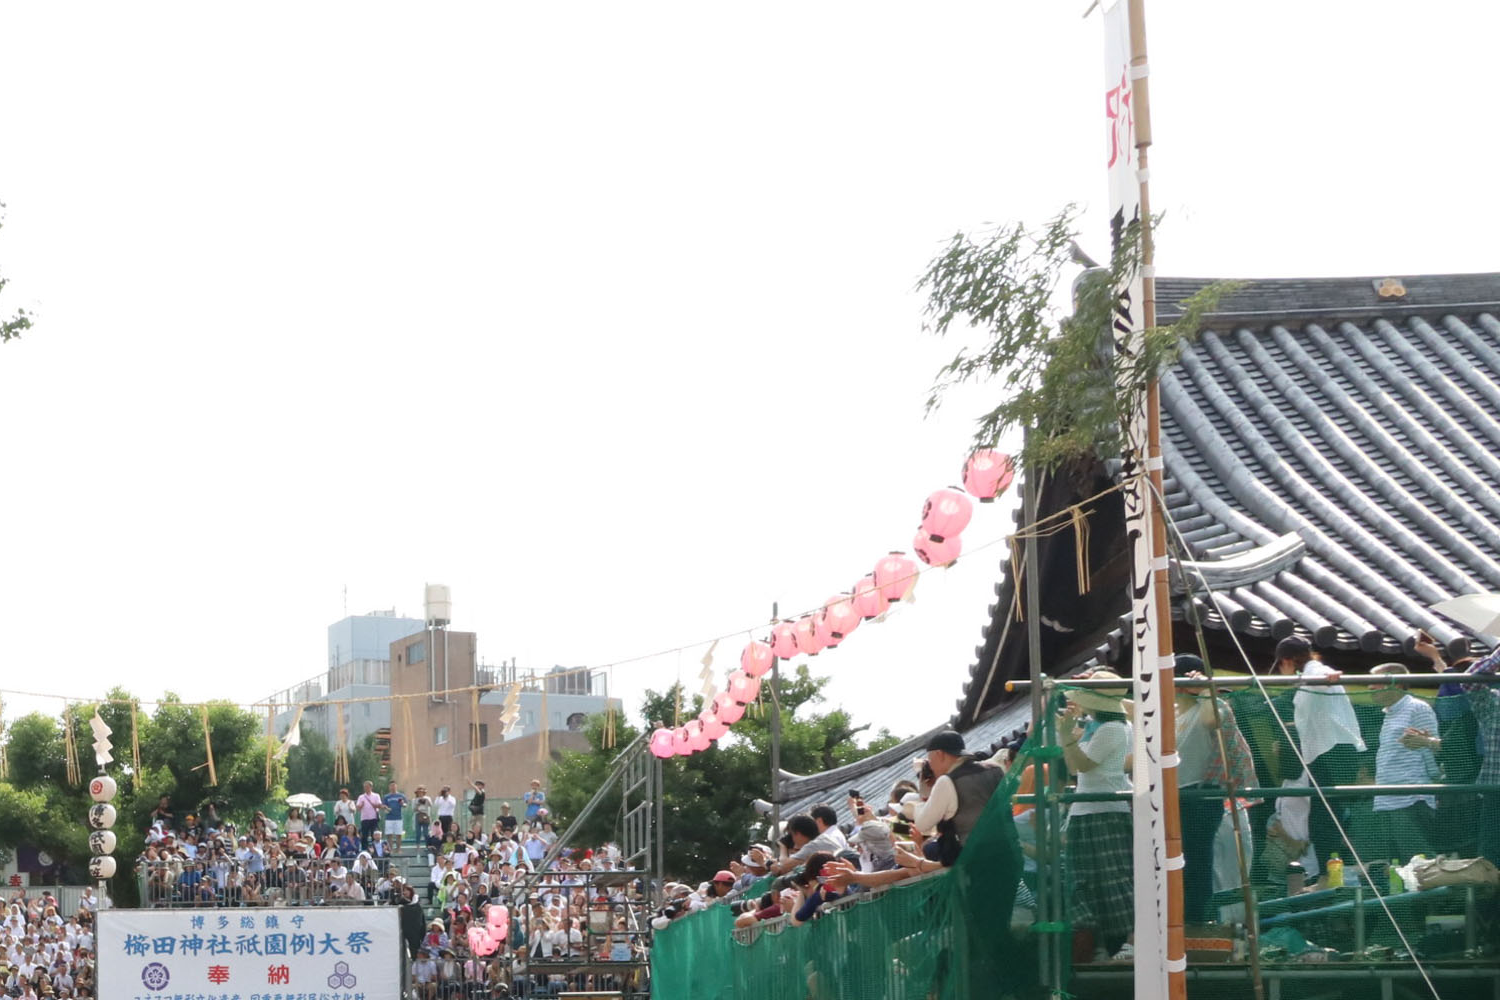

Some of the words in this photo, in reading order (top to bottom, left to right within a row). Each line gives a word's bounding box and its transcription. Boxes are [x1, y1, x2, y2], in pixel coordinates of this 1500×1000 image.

[190, 915, 306, 930] 博多総鎮守
[123, 931, 373, 957] 櫛田神社祇園例大祭
[207, 964, 291, 986] 奉納
